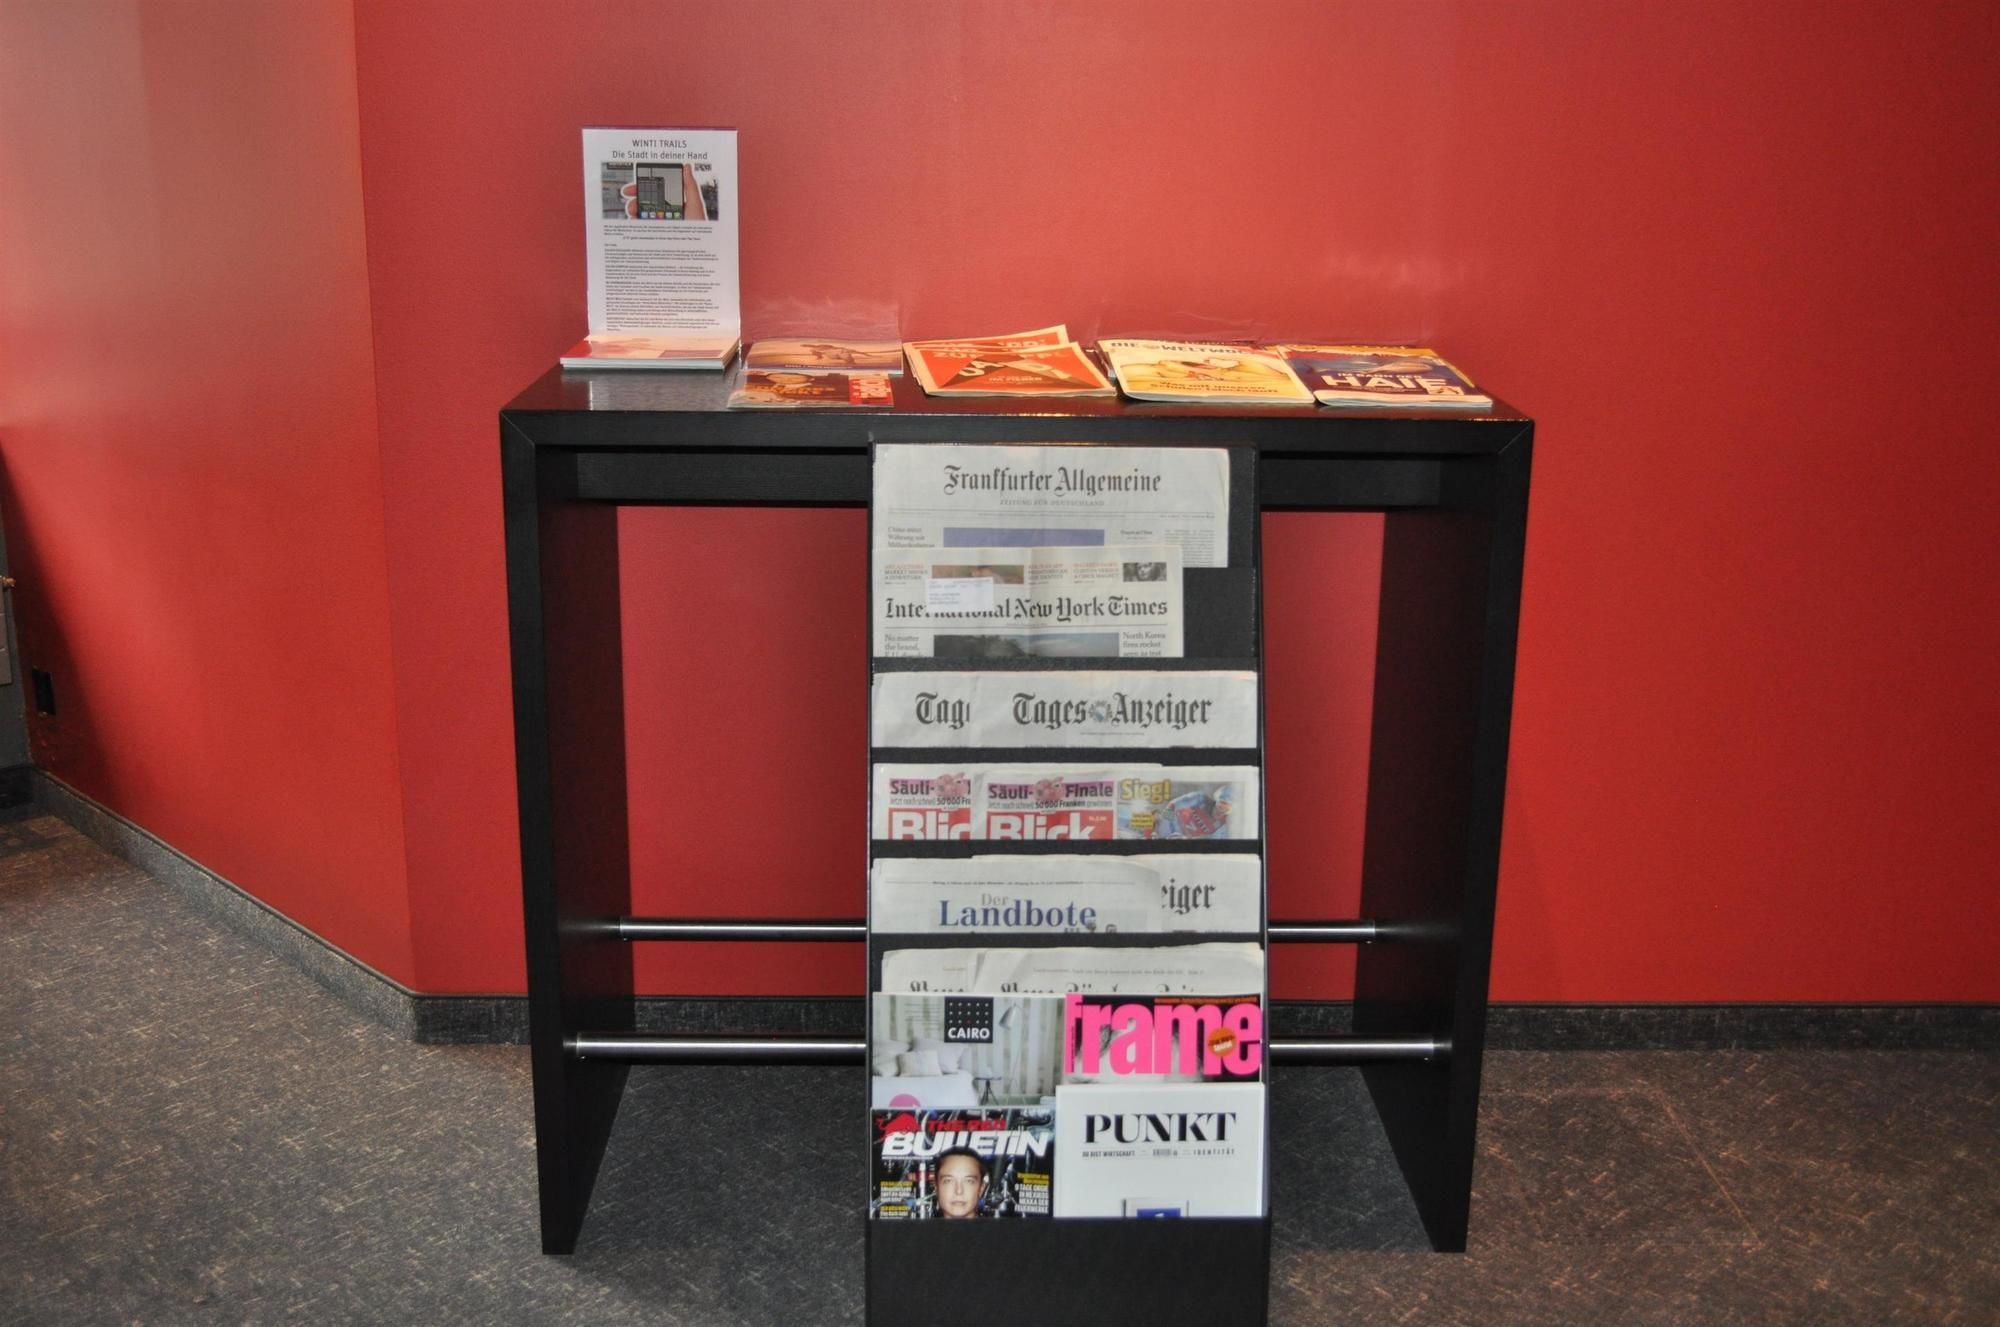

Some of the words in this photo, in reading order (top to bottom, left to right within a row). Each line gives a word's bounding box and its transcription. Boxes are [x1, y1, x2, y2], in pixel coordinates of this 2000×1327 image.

[632, 139, 657, 148] WINTI
[660, 140, 688, 149] TRAILS
[612, 151, 625, 159] Die
[628, 151, 648, 159] Stadt
[650, 151, 658, 160] in
[660, 152, 685, 160] deiner
[687, 152, 708, 160] Hand
[944, 464, 1052, 496] Frankfurter
[1054, 466, 1162, 497] Allgemeine
[1014, 597, 1052, 619] New
[1056, 596, 1105, 622] York
[1108, 595, 1168, 616] Times
[1012, 692, 1088, 730] Tages
[1110, 692, 1212, 730] Anzeiger
[890, 780, 935, 796] Säuli-
[988, 784, 1034, 800] Säuli-
[1065, 783, 1113, 798] Finale
[1120, 778, 1171, 804] Sieg!
[1059, 800, 1086, 808] Franken
[990, 812, 1096, 840] Blick
[980, 892, 1009, 906] Der
[938, 900, 1096, 928] Landbote
[948, 1027, 990, 1040] CAIRO
[1065, 994, 1262, 1076] frame
[928, 1120, 963, 1132] THE
[966, 1120, 1007, 1132] RED
[1084, 1112, 1236, 1144] PUNKT
